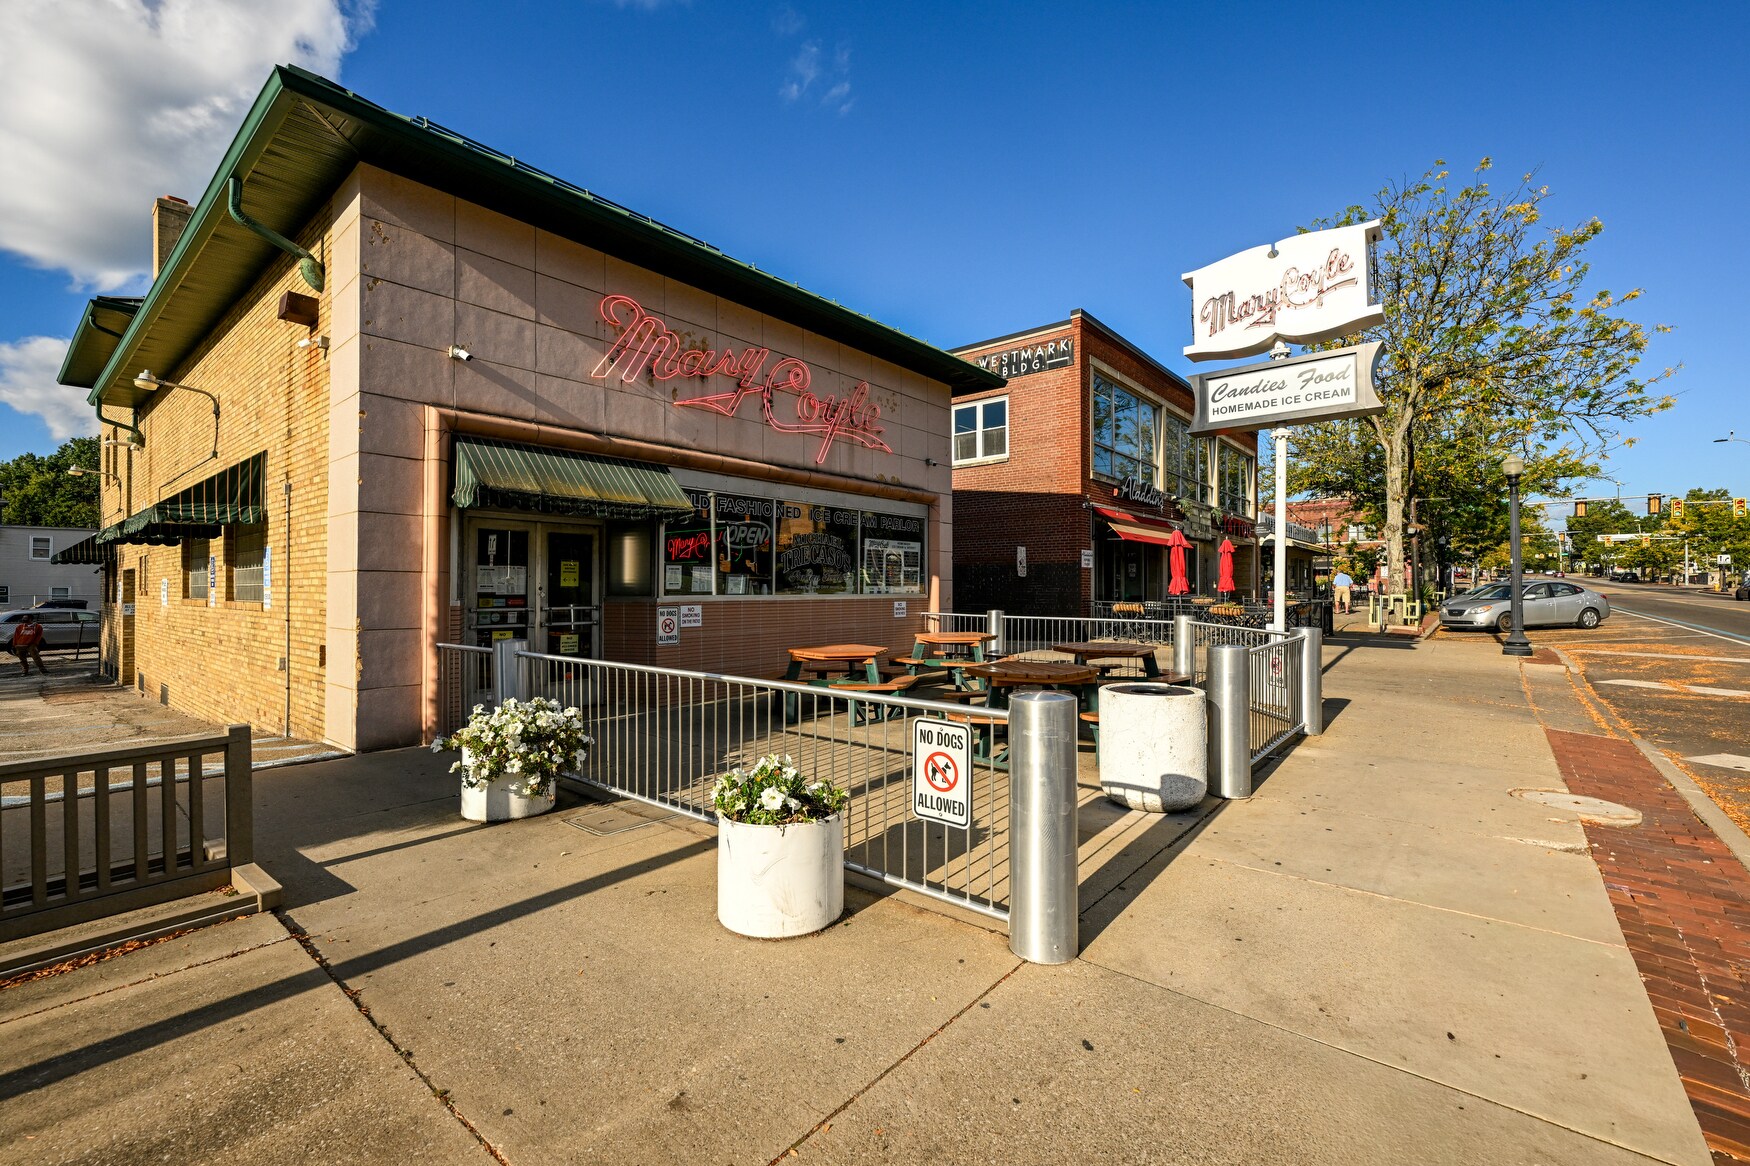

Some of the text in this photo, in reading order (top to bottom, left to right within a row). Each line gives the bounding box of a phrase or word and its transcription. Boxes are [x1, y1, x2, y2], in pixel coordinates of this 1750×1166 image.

[1200, 248, 1358, 338] Mary Coyle
[978, 339, 1069, 369] WESTMARK
[1002, 359, 1046, 377] BLDG.
[591, 294, 893, 464] Mary Coyle
[1211, 364, 1352, 404] Candies Food
[1212, 387, 1351, 416] HOMEMADE ICE CREAM
[717, 496, 801, 518] FASHIONED
[810, 509, 831, 524] ICE
[833, 511, 878, 529] CREAM
[880, 516, 920, 533] PARLOR
[729, 525, 768, 546] OPEN
[919, 728, 964, 750] NO DOGS
[917, 793, 965, 817] ALLOWED
